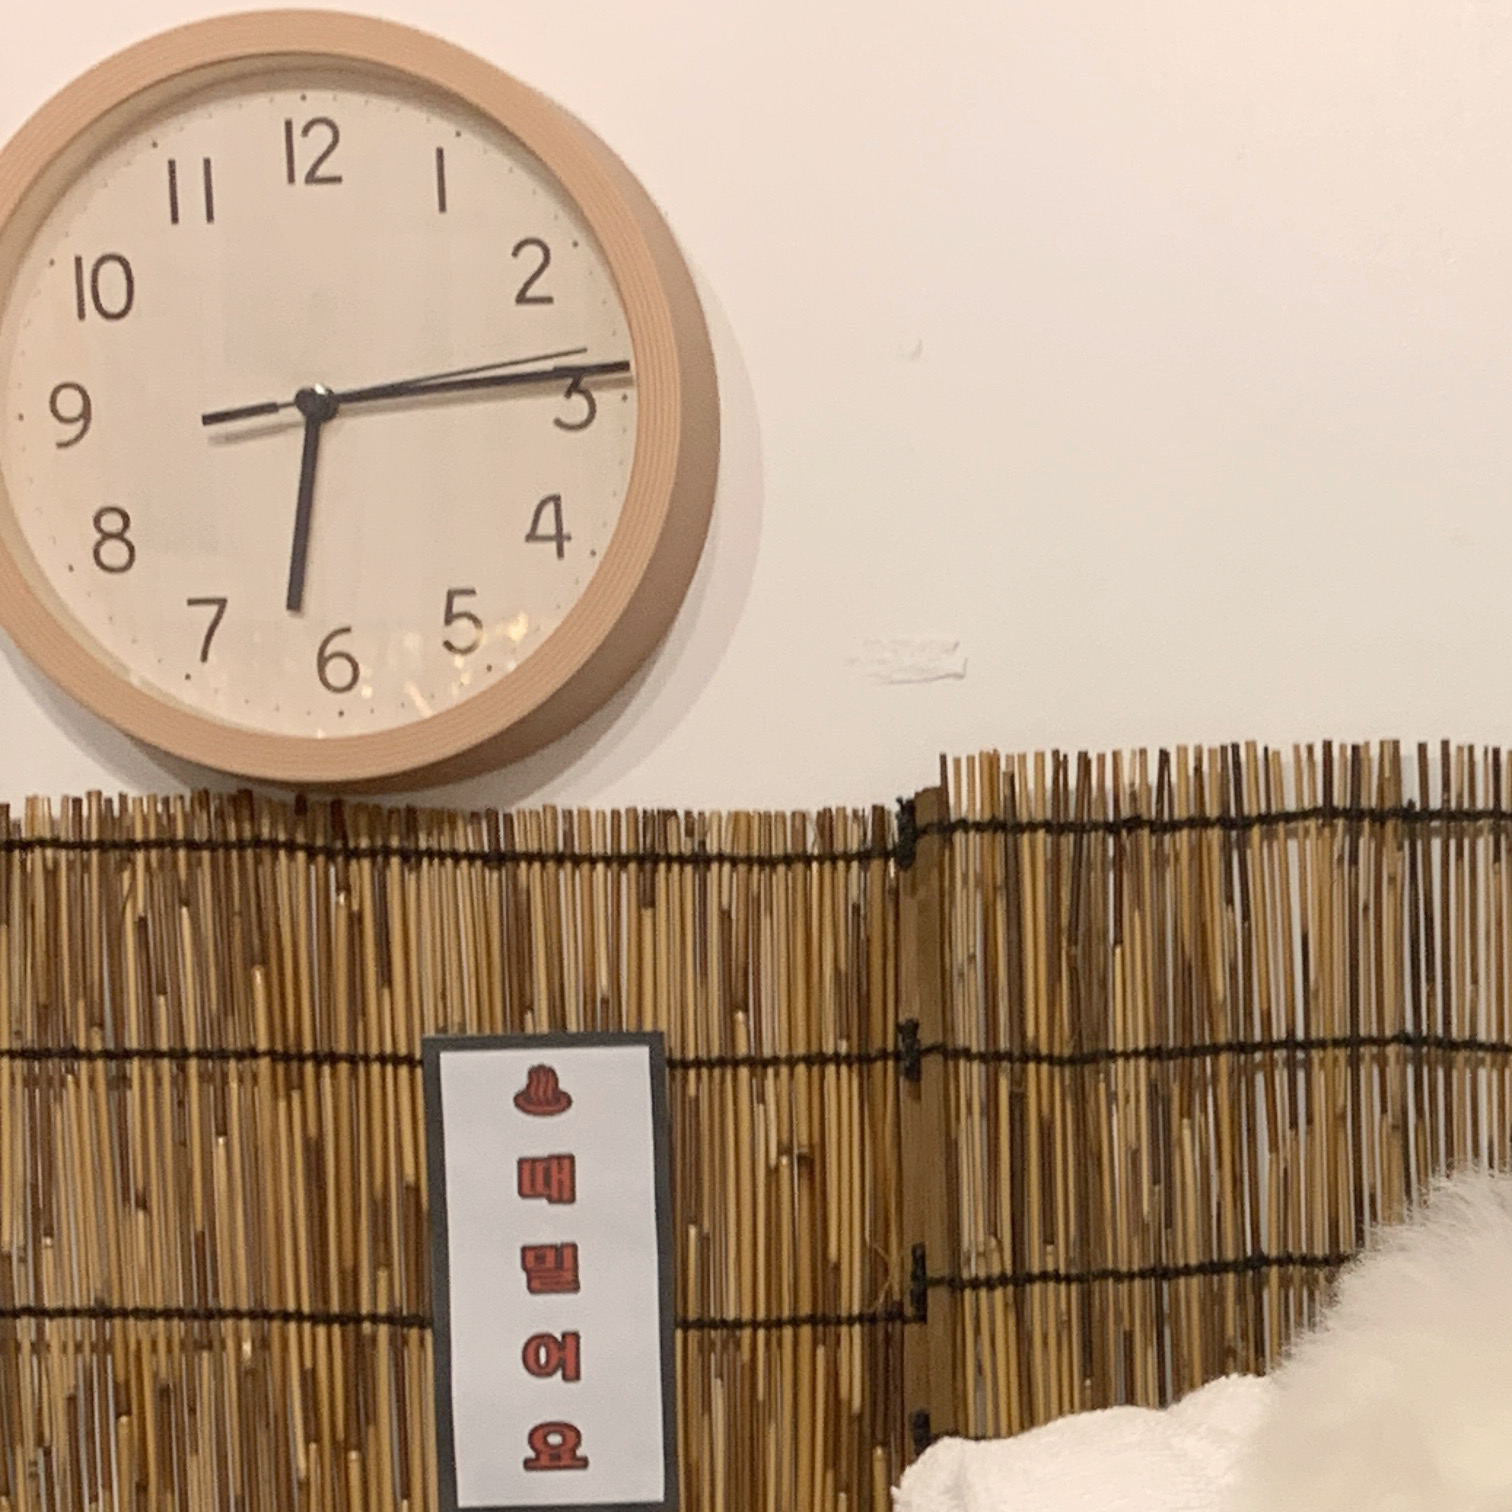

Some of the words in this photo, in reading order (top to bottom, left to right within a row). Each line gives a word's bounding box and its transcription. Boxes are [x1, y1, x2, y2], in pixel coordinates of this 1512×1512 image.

[283, 116, 343, 186] 12
[434, 146, 448, 213] 1
[167, 156, 215, 225] 11
[73, 252, 136, 322] 10
[510, 237, 555, 306] 2
[48, 381, 93, 449] 9
[553, 364, 598, 432] 3
[91, 506, 136, 574] 8
[524, 494, 573, 560] 4
[186, 597, 229, 664] 7
[441, 587, 484, 656] 5
[315, 626, 361, 695] 6
